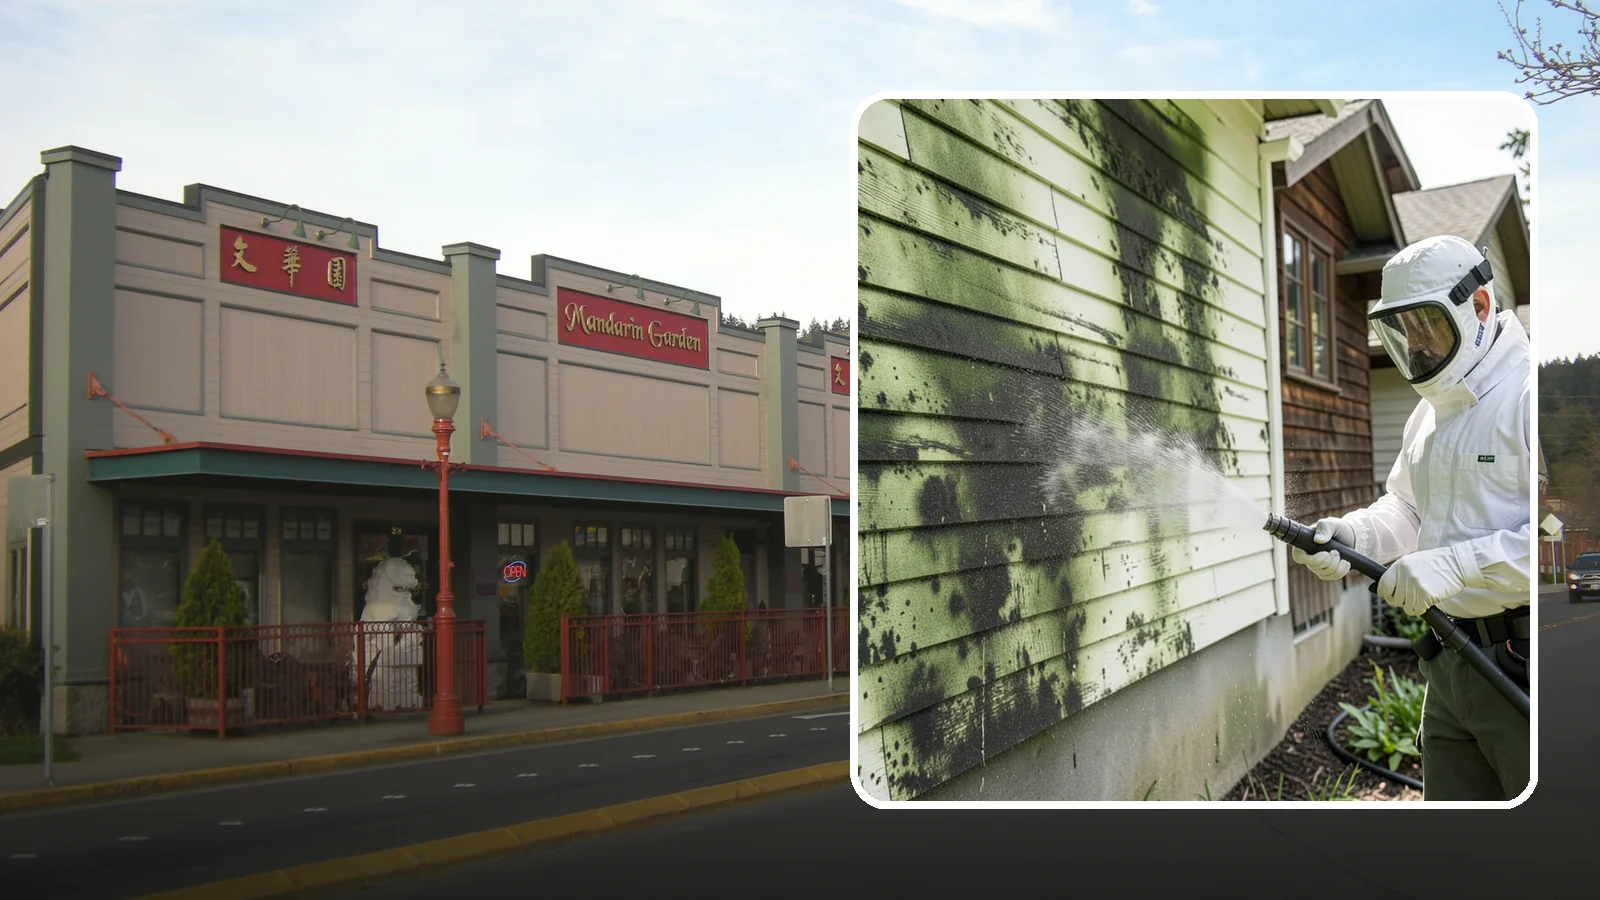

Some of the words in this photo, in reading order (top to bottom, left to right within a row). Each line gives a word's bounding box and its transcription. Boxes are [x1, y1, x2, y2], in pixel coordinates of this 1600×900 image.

[230, 235, 346, 291] 文華園
[564, 302, 644, 341] Mandarin
[648, 320, 701, 352] Garden
[503, 565, 527, 578] OPEN
